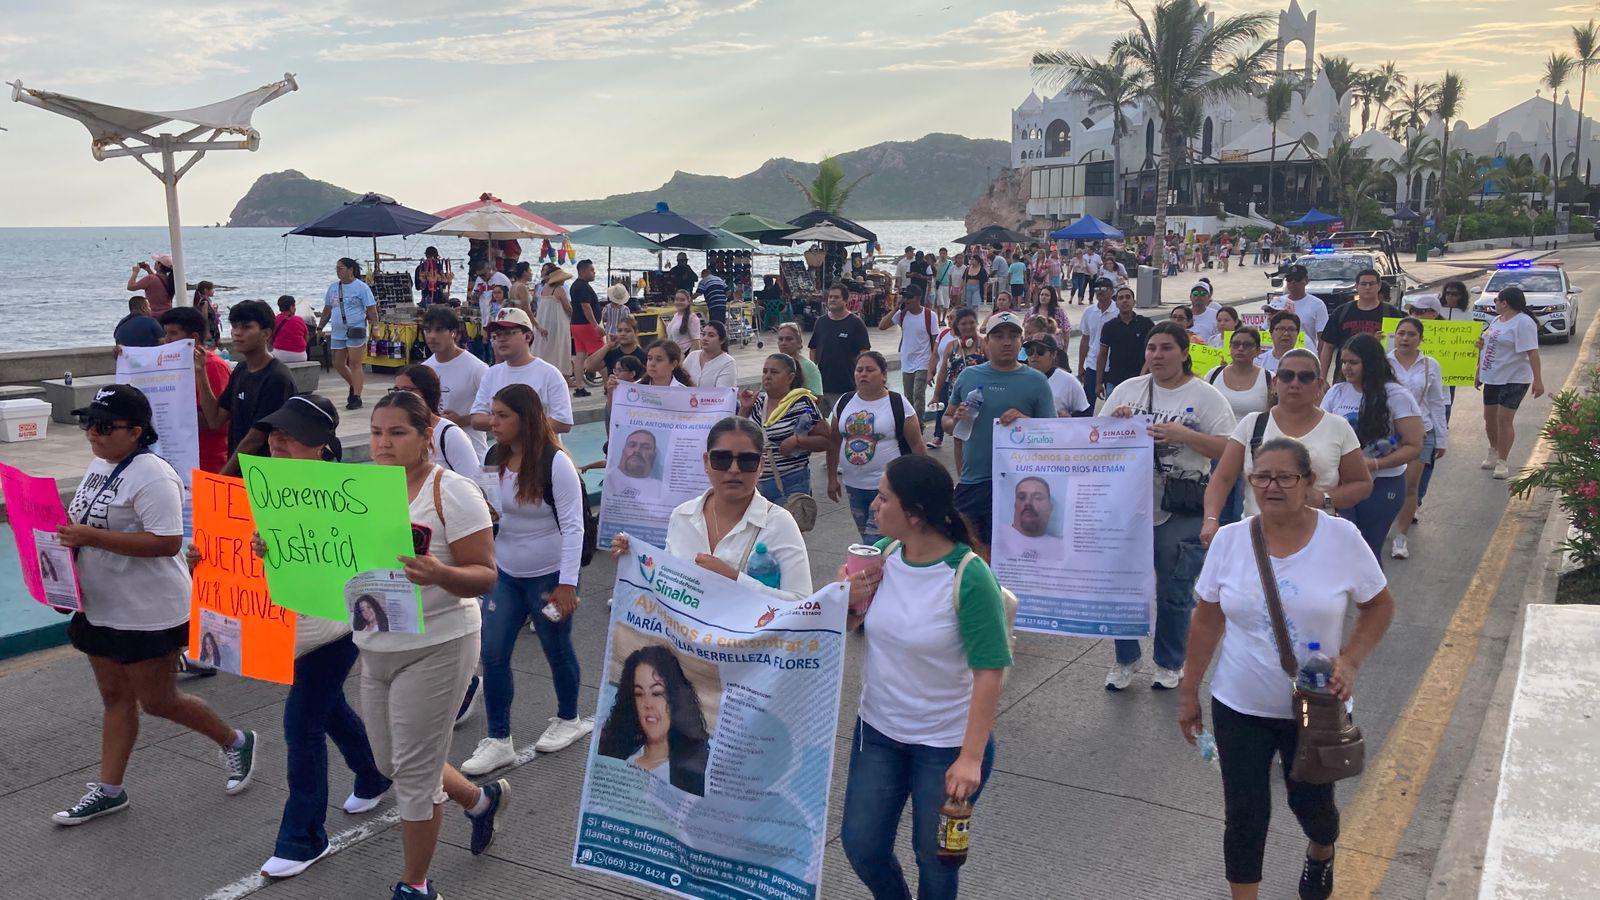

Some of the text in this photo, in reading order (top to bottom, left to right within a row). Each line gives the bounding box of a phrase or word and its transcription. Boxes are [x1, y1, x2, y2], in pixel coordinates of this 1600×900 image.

[645, 421, 674, 429] ANTONIO
[1026, 434, 1054, 444] Sinaloa
[1016, 464, 1126, 473] LUIS ANTONIO RÍOS ALEMÁN
[204, 477, 250, 521] TE
[194, 528, 265, 578] QUERE
[655, 578, 700, 609] Sinaloa
[626, 611, 662, 634] MARÍA
[696, 648, 771, 666] BERRELLEZA
[774, 656, 820, 670] FLORES
[808, 640, 819, 652] a
[585, 829, 612, 842] llama
[613, 836, 621, 844] o
[735, 875, 756, 888] muy
[587, 817, 598, 827] Si
[601, 820, 631, 835] tienes
[747, 867, 769, 879] esta
[604, 854, 667, 880] (669) 327 8424
